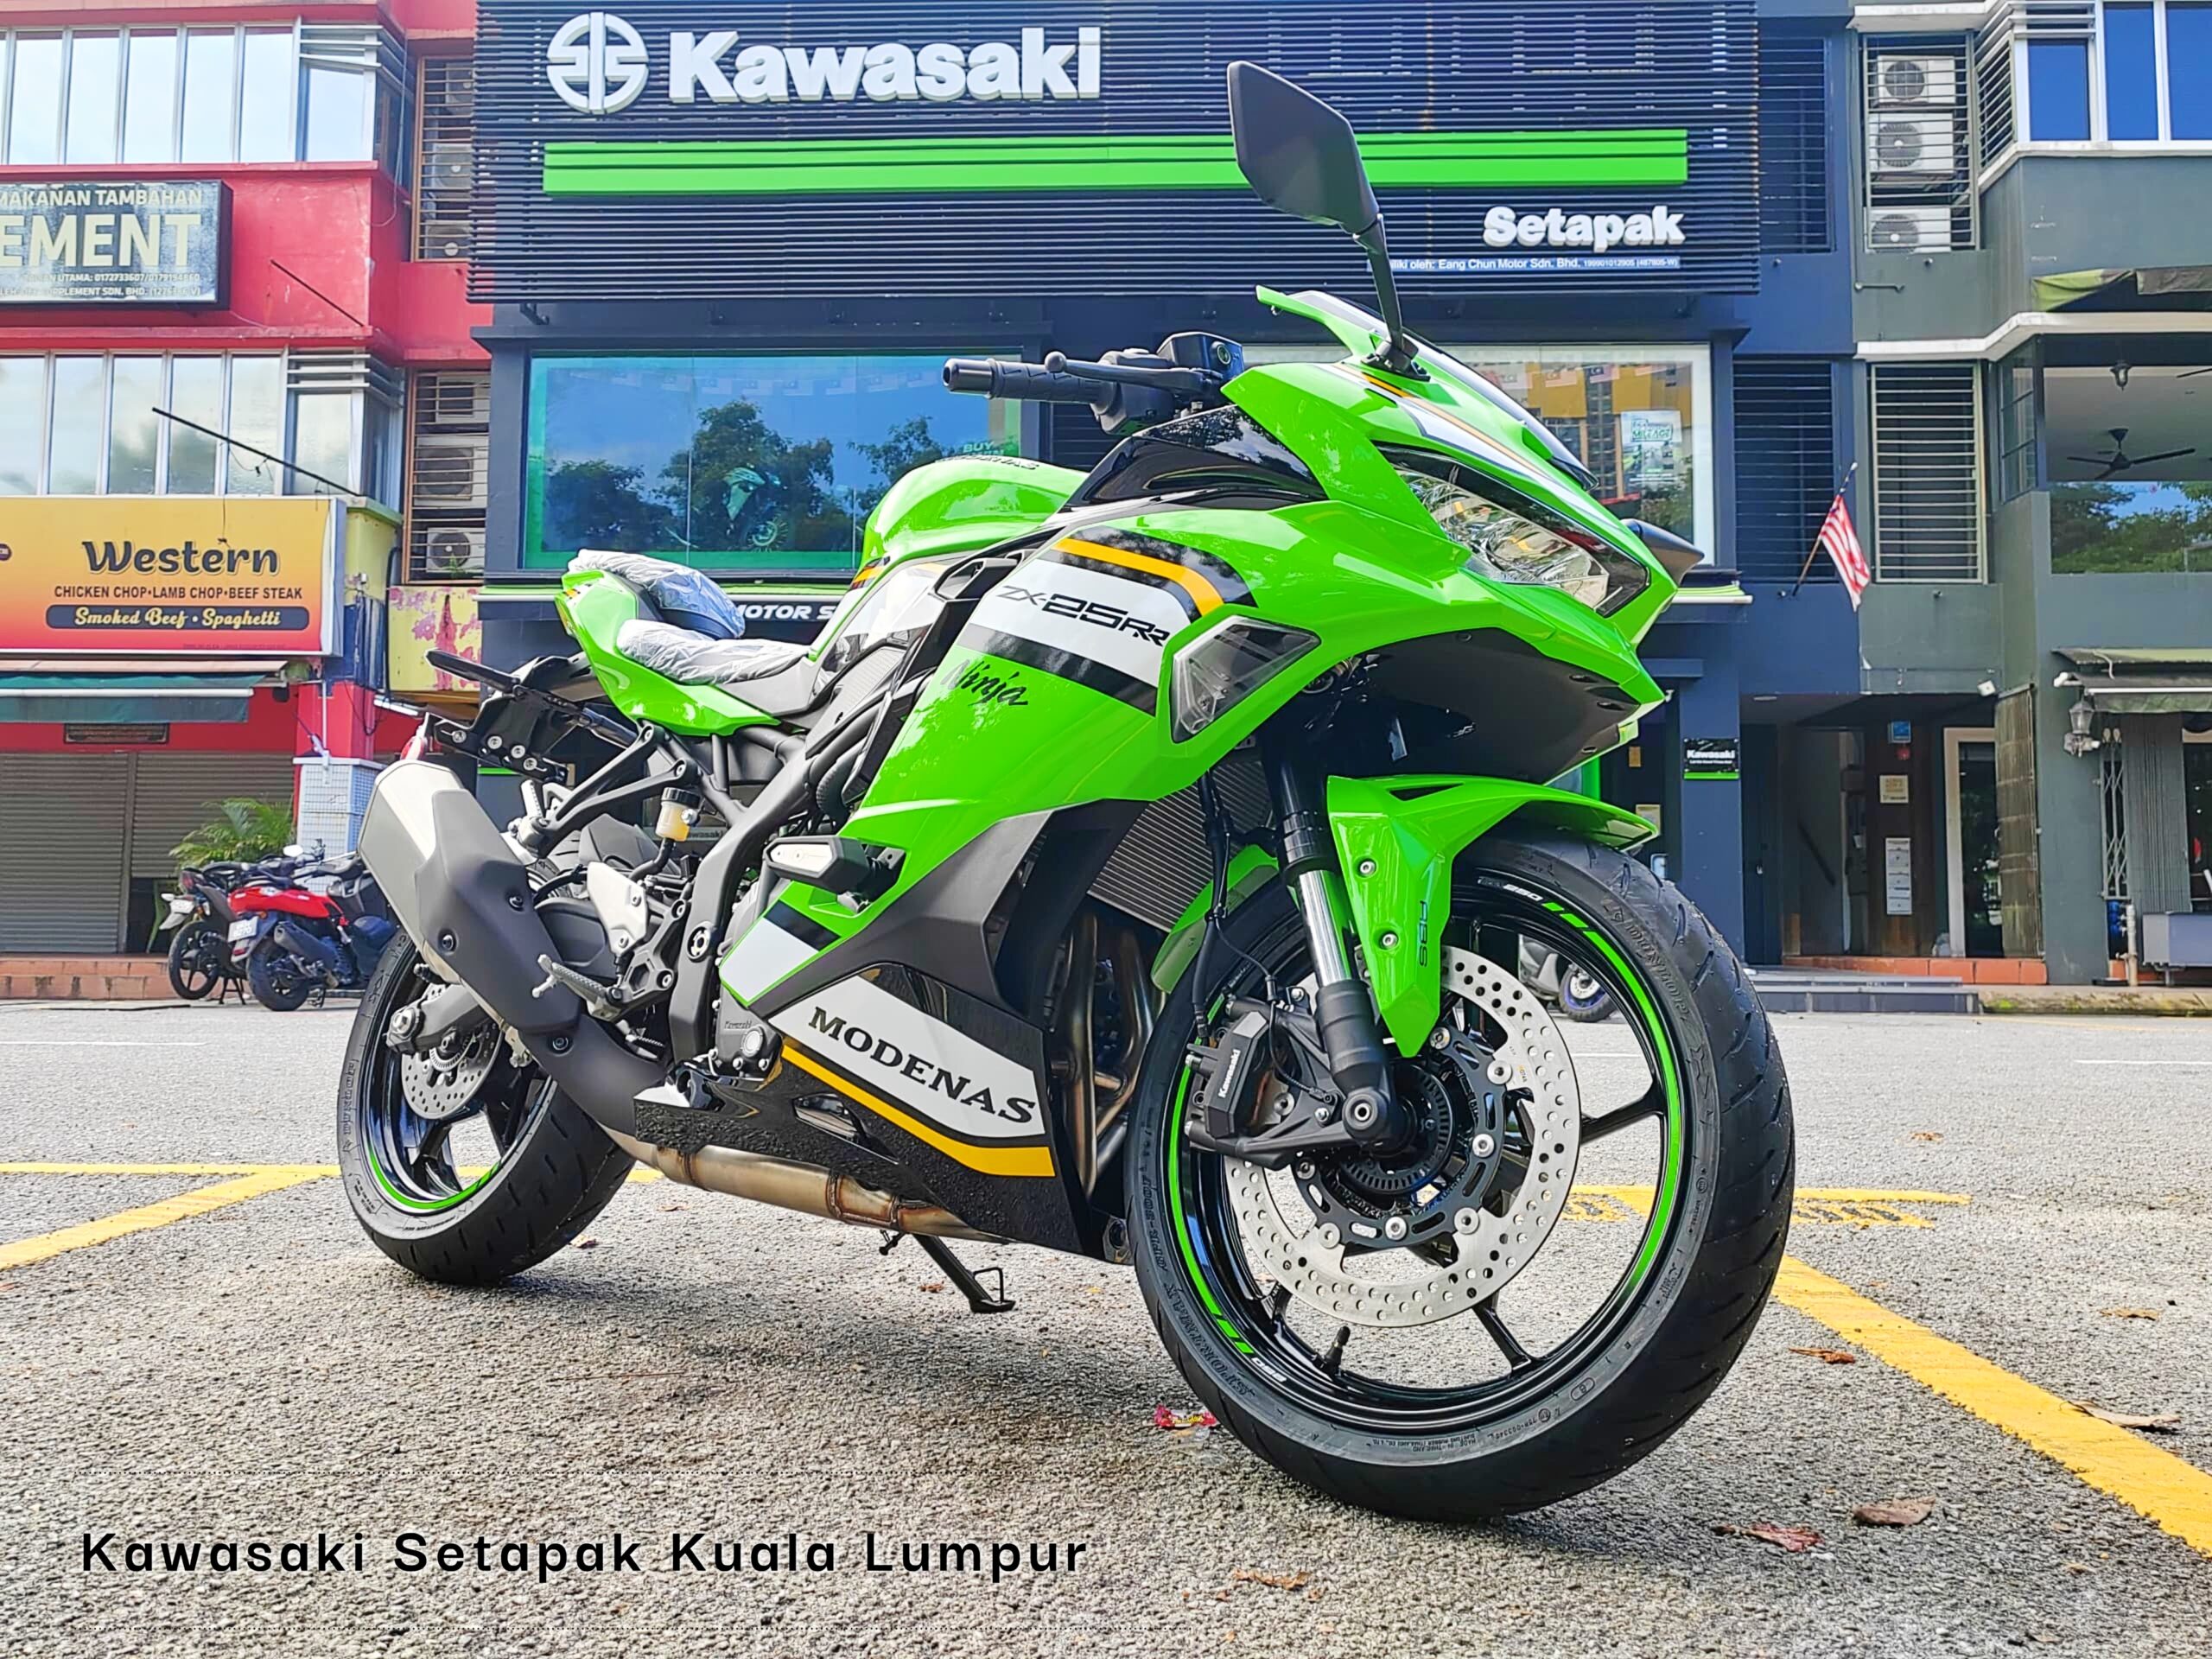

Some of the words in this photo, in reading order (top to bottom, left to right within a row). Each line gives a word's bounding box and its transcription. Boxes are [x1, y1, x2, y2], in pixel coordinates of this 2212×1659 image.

[669, 26, 1101, 104] Kawasaki
[95, 189, 202, 206] TAMBAHAN
[1483, 205, 1686, 253] Setapak
[1411, 259, 1435, 270] oleh:
[1439, 259, 1465, 270] Eang
[1468, 259, 1496, 269] Chun
[1498, 258, 1528, 269] Motor
[1530, 258, 1554, 268] Sdn.
[1557, 257, 1580, 268] Bhd.
[963, 442, 994, 453] BUY
[81, 539, 280, 576] Western
[54, 586, 110, 599] CHICKEN
[113, 586, 148, 600] CHOP
[152, 586, 186, 599] LAMB
[189, 586, 225, 599] CHOP
[228, 586, 259, 599] BEEF
[263, 586, 302, 600] STEAK
[74, 607, 140, 626] Smoked
[145, 607, 188, 629] Beef
[201, 607, 282, 630] Spaghetti
[940, 660, 1029, 706] Ninja
[1687, 749, 1736, 759] Kawasaki
[1419, 899, 1428, 967] ABS
[807, 1006, 1036, 1123] MODENAS
[1217, 1048, 1242, 1098] Kawasaki
